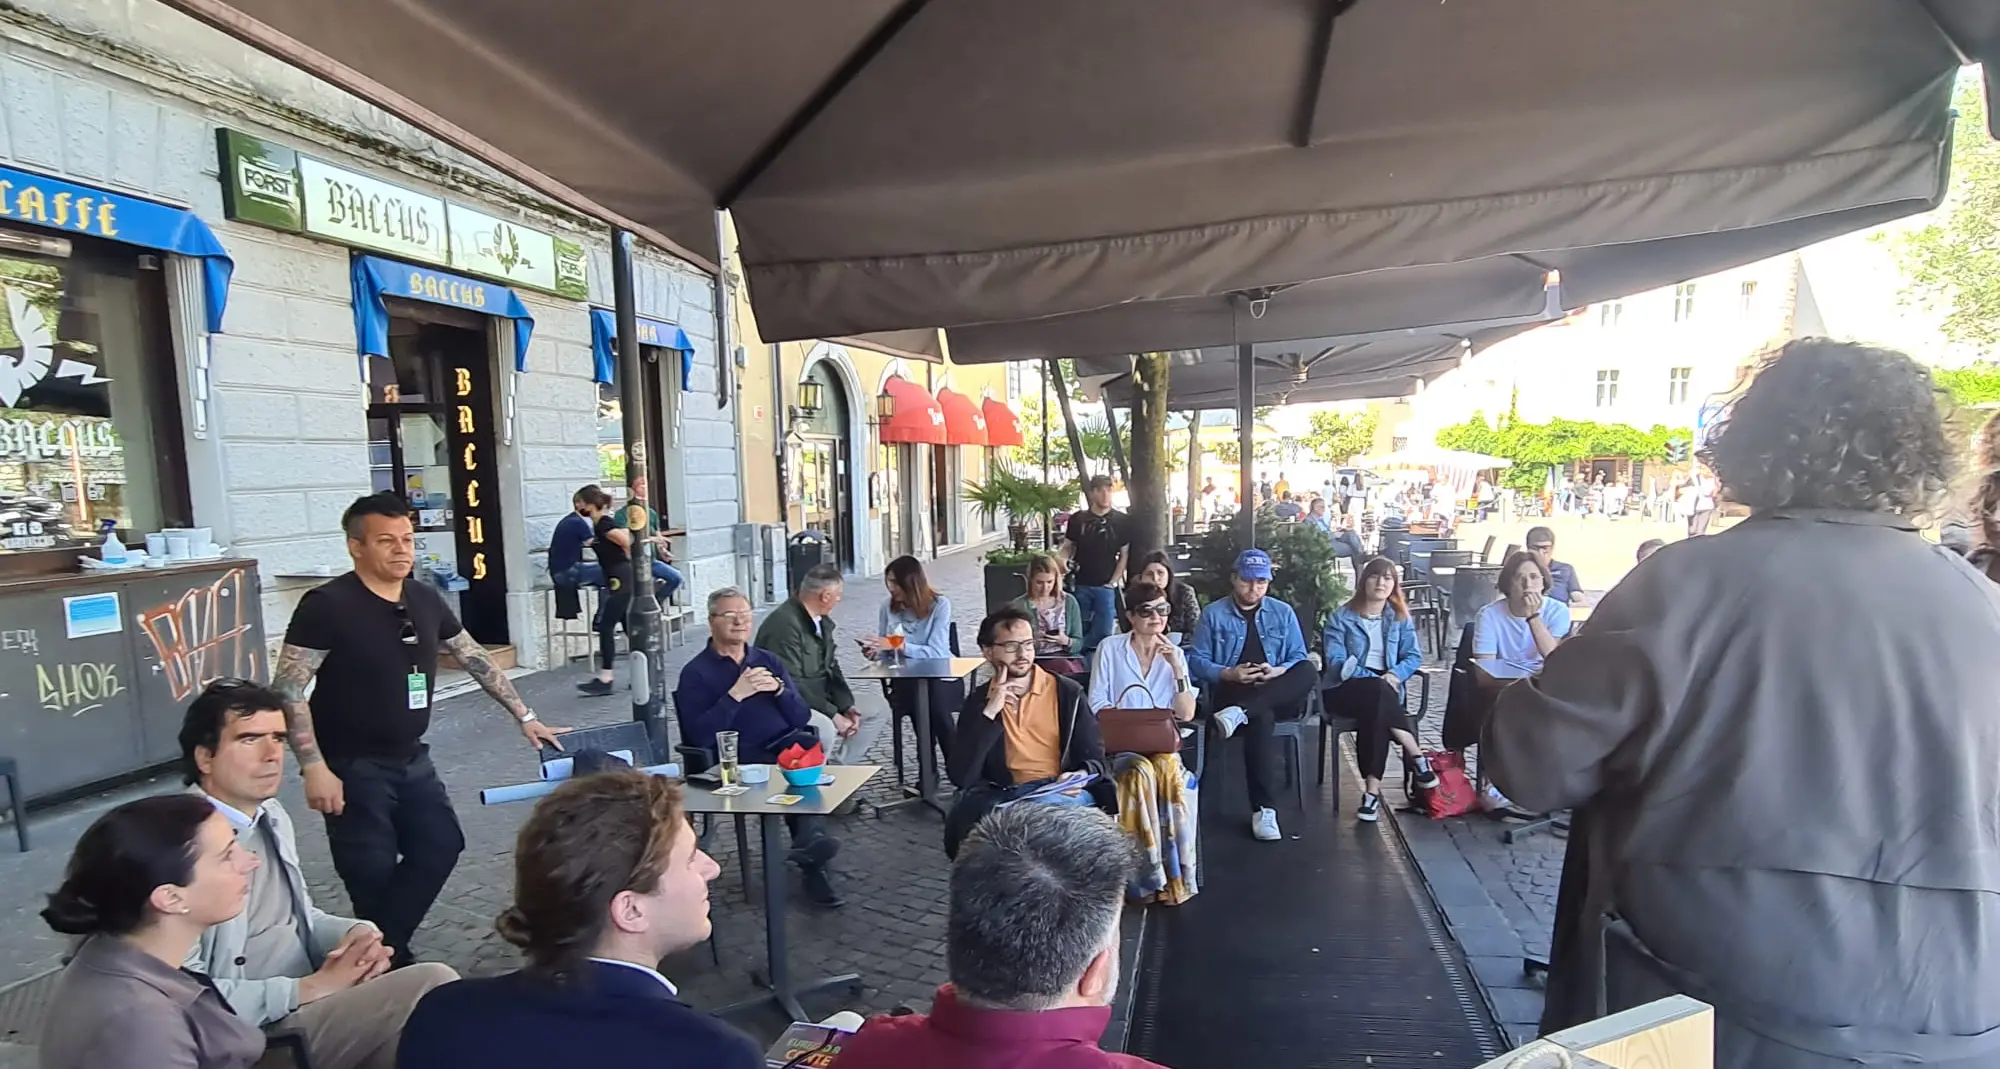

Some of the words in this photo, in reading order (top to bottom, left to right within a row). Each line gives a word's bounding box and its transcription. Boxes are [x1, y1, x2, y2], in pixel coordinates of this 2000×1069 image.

[244, 168, 292, 196] FORST
[324, 177, 430, 245] BACCUS
[409, 272, 485, 308] BACCUS
[455, 367, 487, 580] BACCUS
